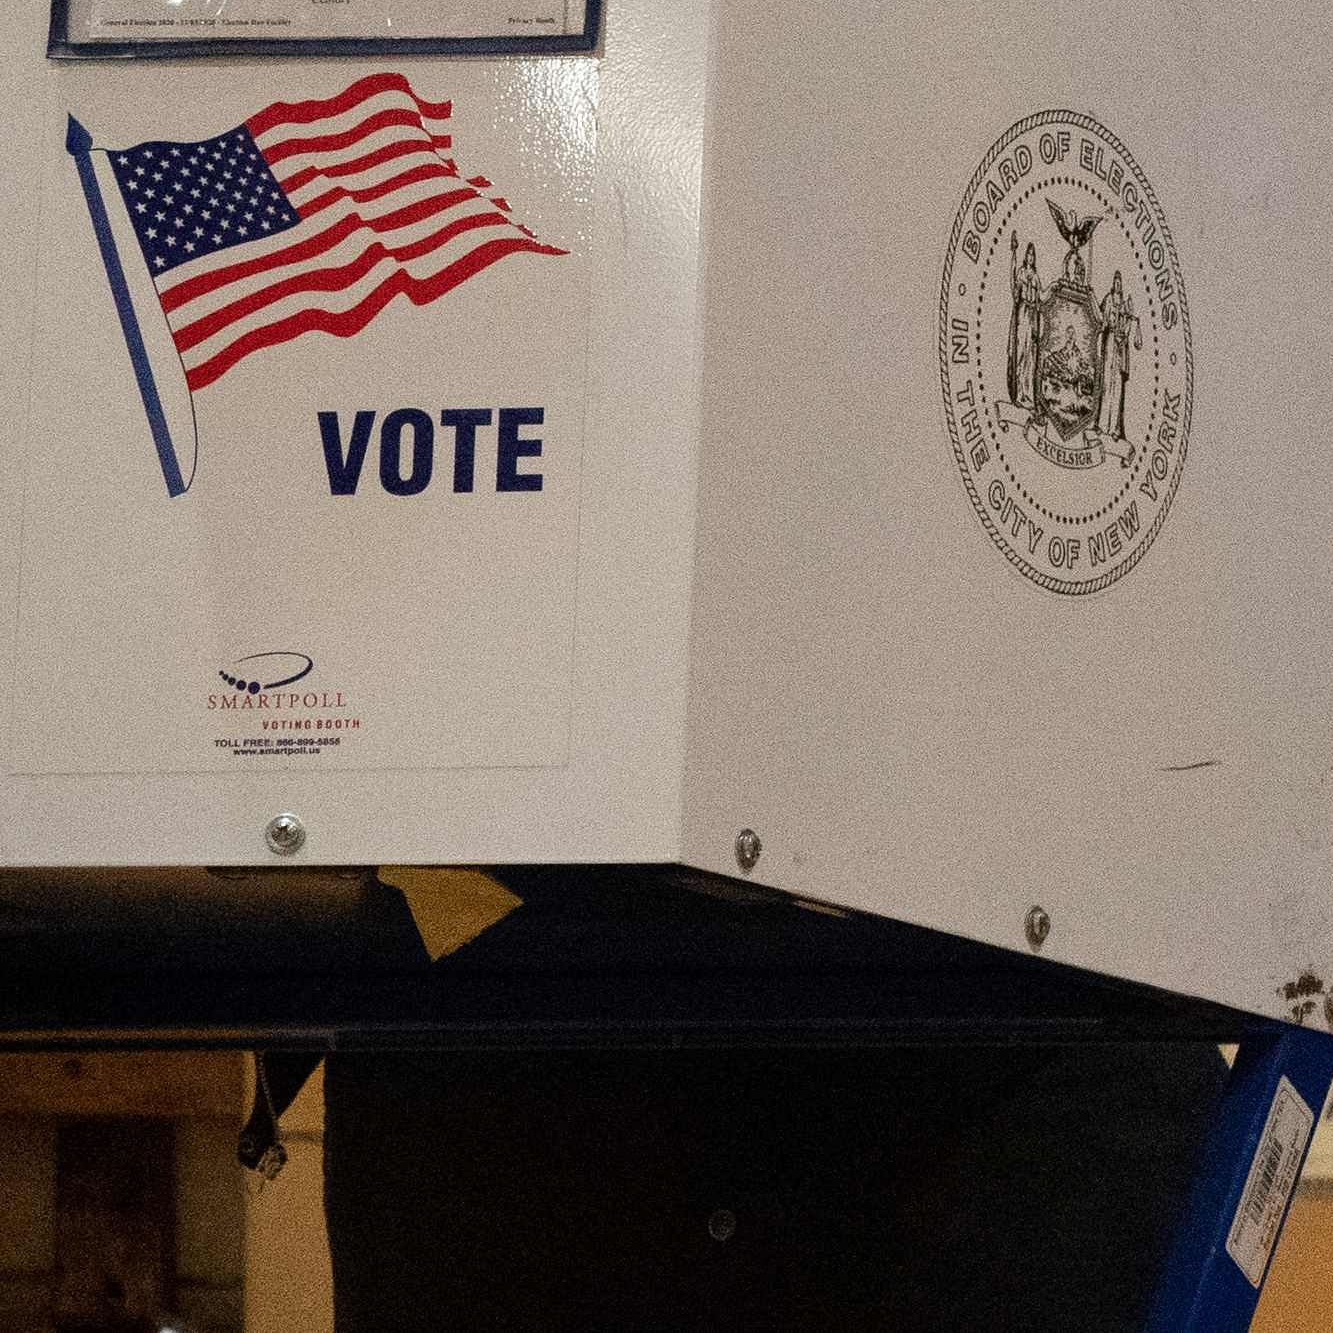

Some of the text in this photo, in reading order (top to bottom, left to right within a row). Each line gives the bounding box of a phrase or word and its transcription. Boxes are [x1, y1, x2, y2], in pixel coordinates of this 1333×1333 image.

[961, 131, 1179, 331] BOARD OF ELECTIONS
[317, 406, 546, 497] VOTE
[951, 318, 1181, 569] IN THE CITY OF NEW YORK
[1035, 437, 1093, 466] EXCELSIOR
[207, 692, 348, 710] SMARTPOLL
[262, 718, 360, 730] VOTING BOOTH
[214, 739, 241, 748] TOLL
[243, 738, 273, 747] FREE:
[233, 747, 321, 757] www.smartpoll.us
